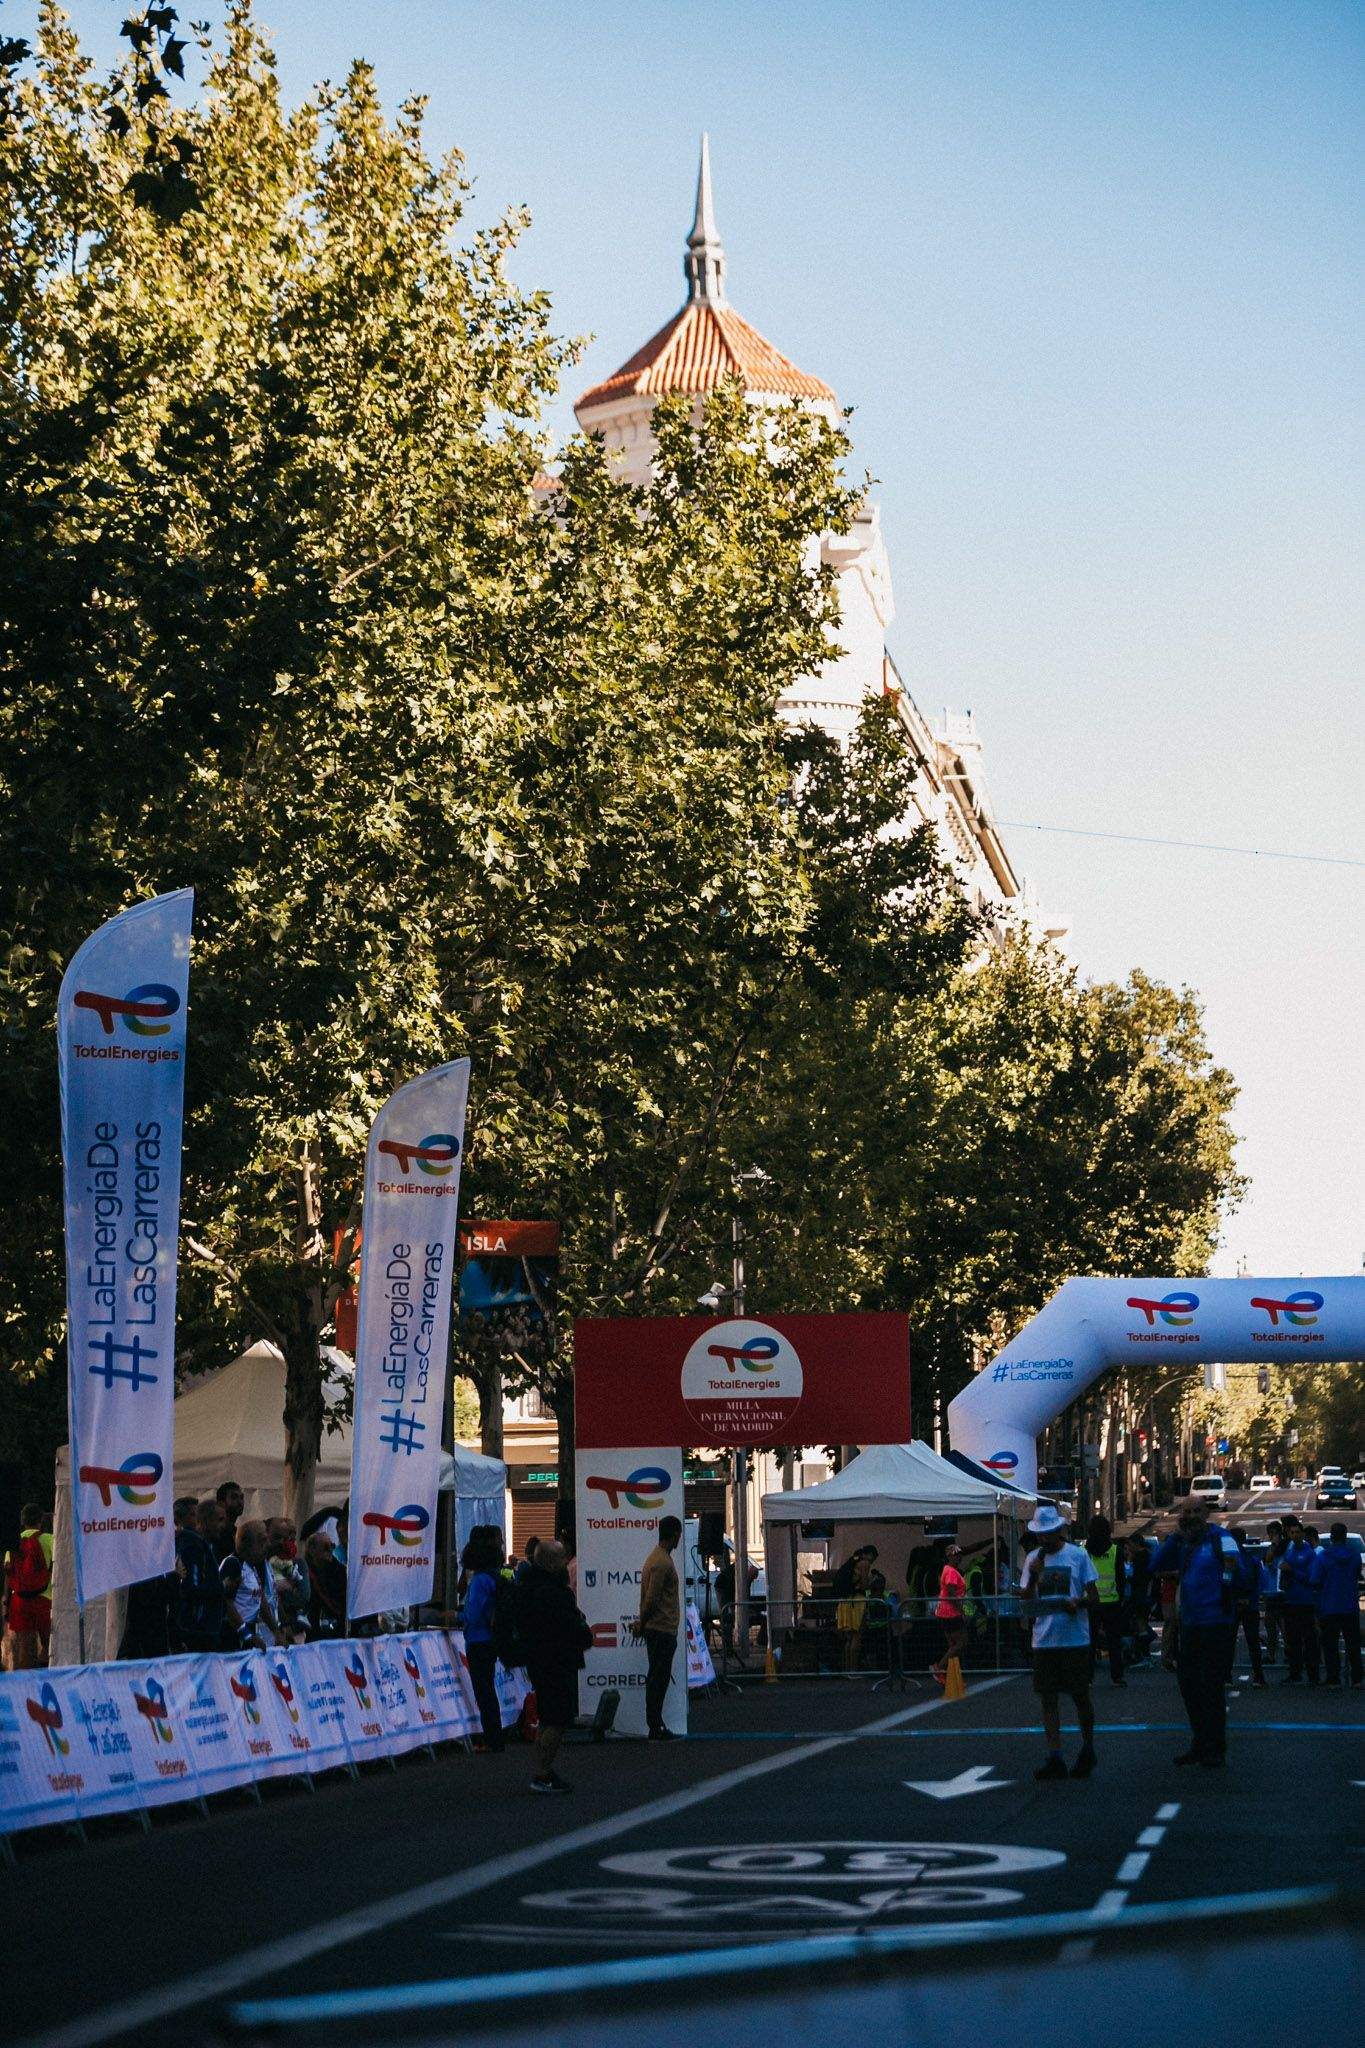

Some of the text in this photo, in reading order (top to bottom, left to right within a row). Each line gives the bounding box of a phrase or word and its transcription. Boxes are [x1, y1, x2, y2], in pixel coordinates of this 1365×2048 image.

[73, 1045, 179, 1064] TotalEnergies
[377, 1182, 456, 1197] TotalEnergies
[467, 1236, 507, 1252] ISLA
[1126, 1332, 1200, 1344] TotalEnergies
[1250, 1332, 1324, 1345] TotalEnergies
[708, 1378, 781, 1391] TotalEnergies
[726, 1401, 760, 1410] MILLA
[713, 1423, 774, 1432] DE MADRID
[587, 1516, 660, 1531] TotalEnergi
[361, 1554, 429, 1568] TotalEnergies
[607, 1570, 643, 1585] MAD
